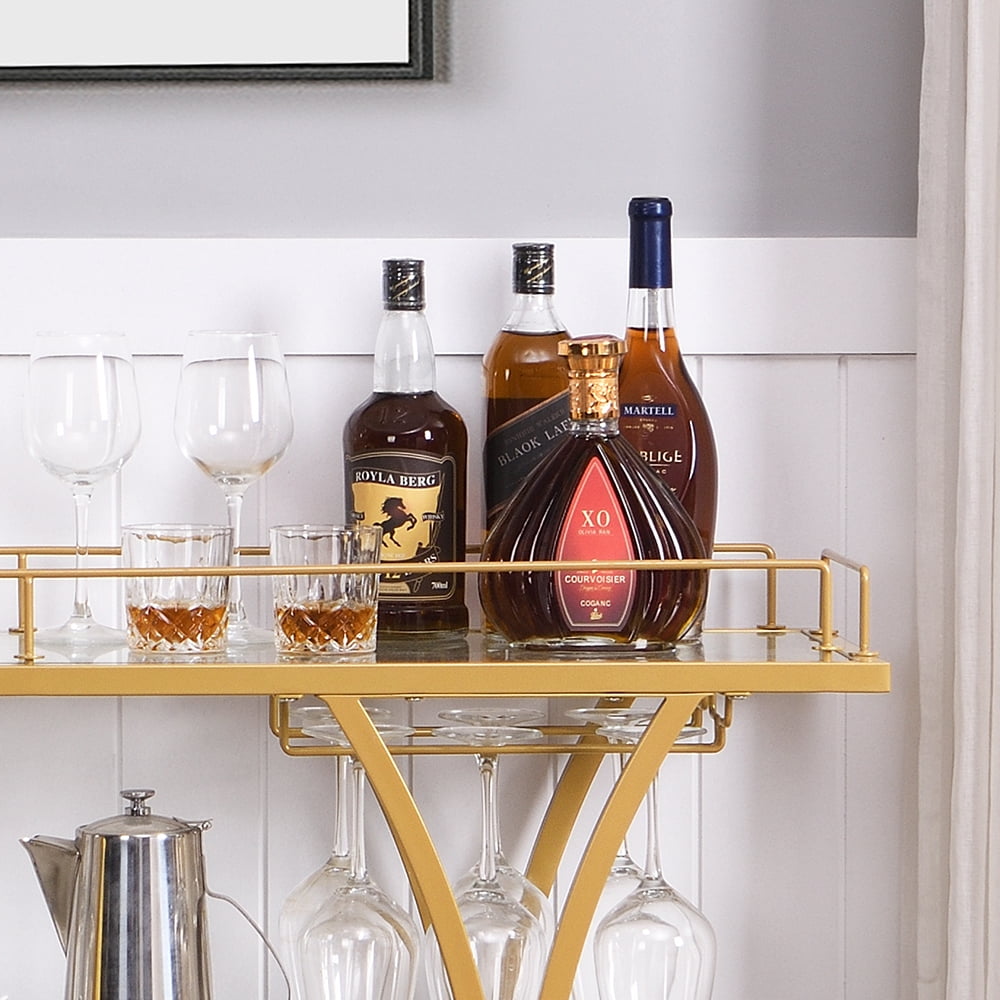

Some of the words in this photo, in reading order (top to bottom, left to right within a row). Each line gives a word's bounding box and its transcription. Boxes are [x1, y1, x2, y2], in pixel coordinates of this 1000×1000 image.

[624, 406, 675, 416] MARTELL
[355, 470, 396, 484] ROYLA
[400, 474, 436, 487] BERG
[581, 509, 611, 528] XO
[564, 575, 626, 584] COURVOISIER
